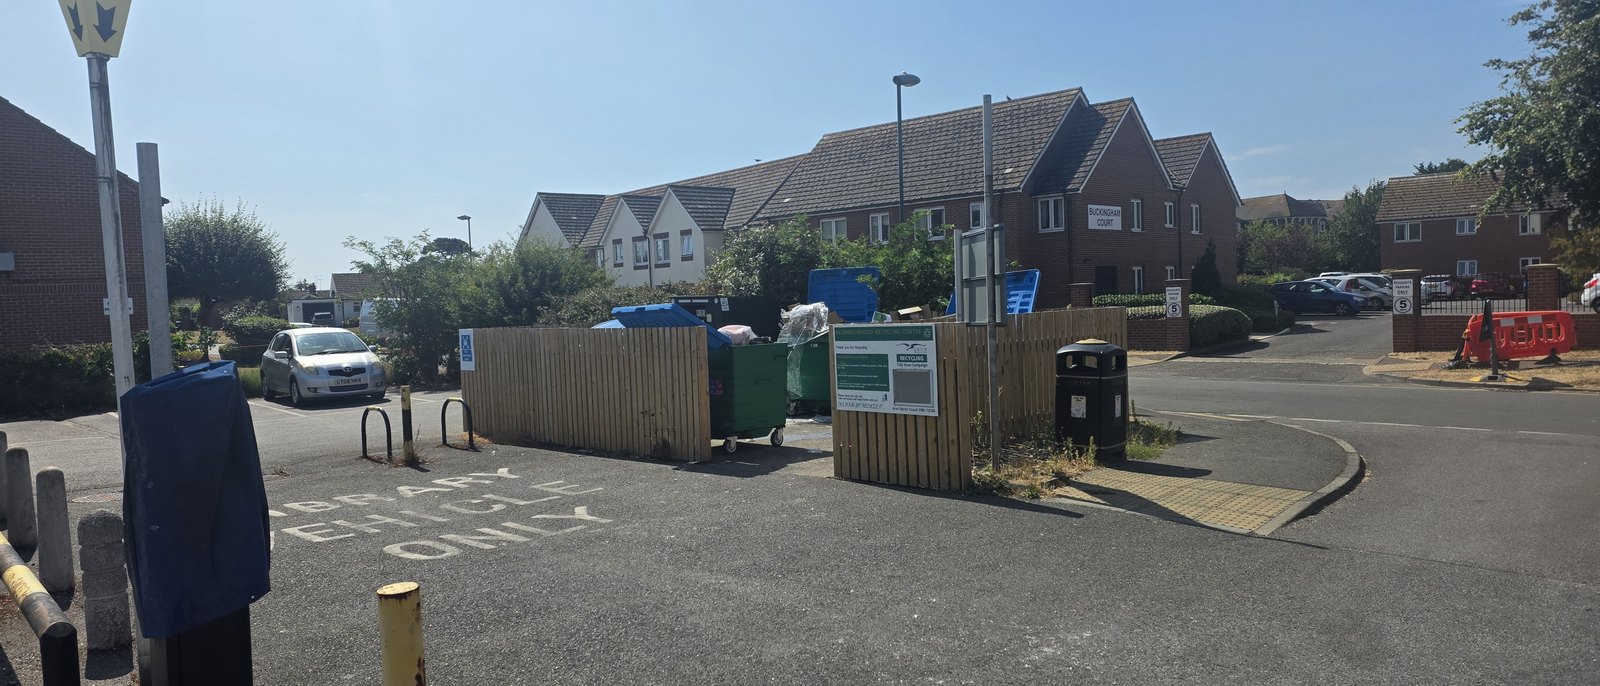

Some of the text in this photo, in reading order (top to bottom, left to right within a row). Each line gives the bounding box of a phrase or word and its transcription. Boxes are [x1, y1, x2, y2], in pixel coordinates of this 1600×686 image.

[1089, 208, 1120, 217] BUCKINGHAM
[1096, 218, 1113, 226] COURT
[1400, 300, 1407, 308] 5
[268, 467, 520, 517] BRARY
[270, 480, 604, 550] EHICLE
[383, 505, 614, 561] ONLY
